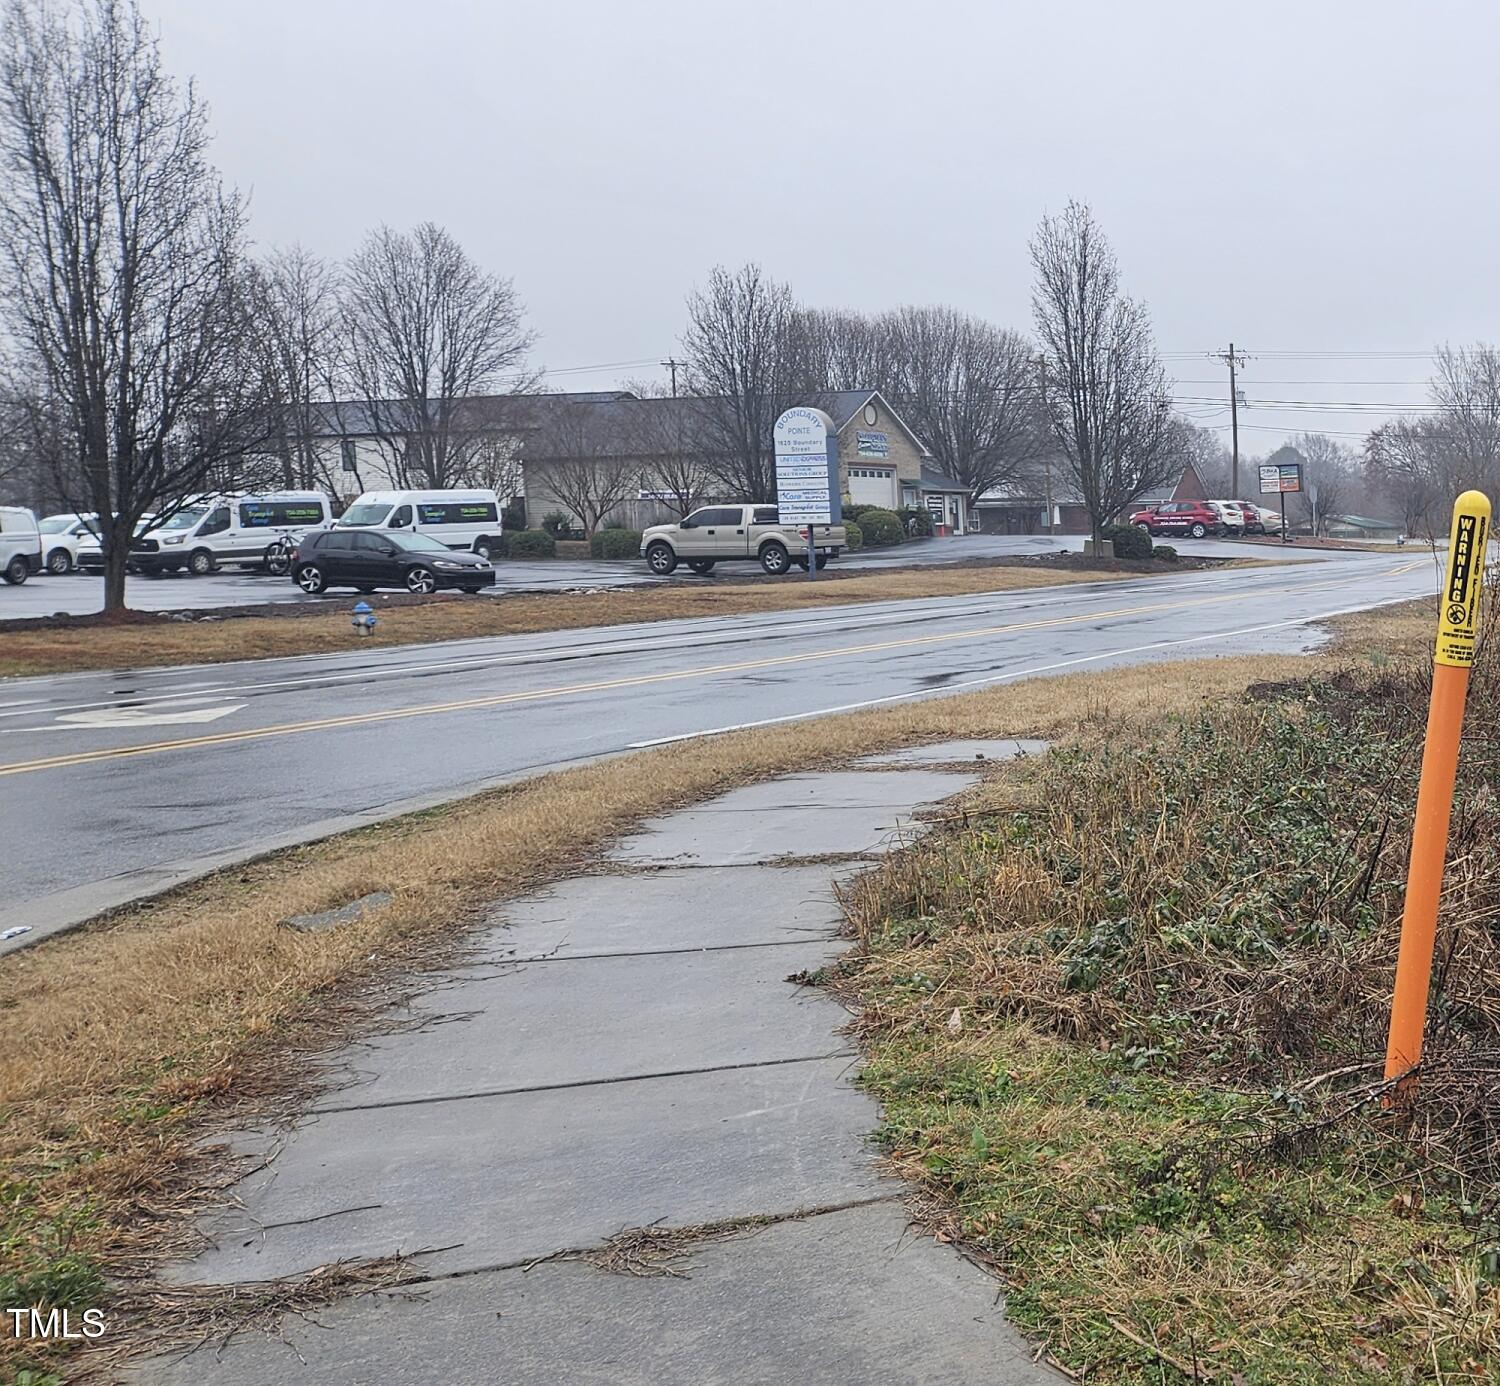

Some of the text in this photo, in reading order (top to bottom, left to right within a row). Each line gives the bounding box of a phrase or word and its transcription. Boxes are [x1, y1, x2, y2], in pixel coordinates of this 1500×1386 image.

[777, 410, 822, 429] BOUNDARY
[1452, 518, 1473, 602] WARNING
[1474, 516, 1486, 575] BURIED
